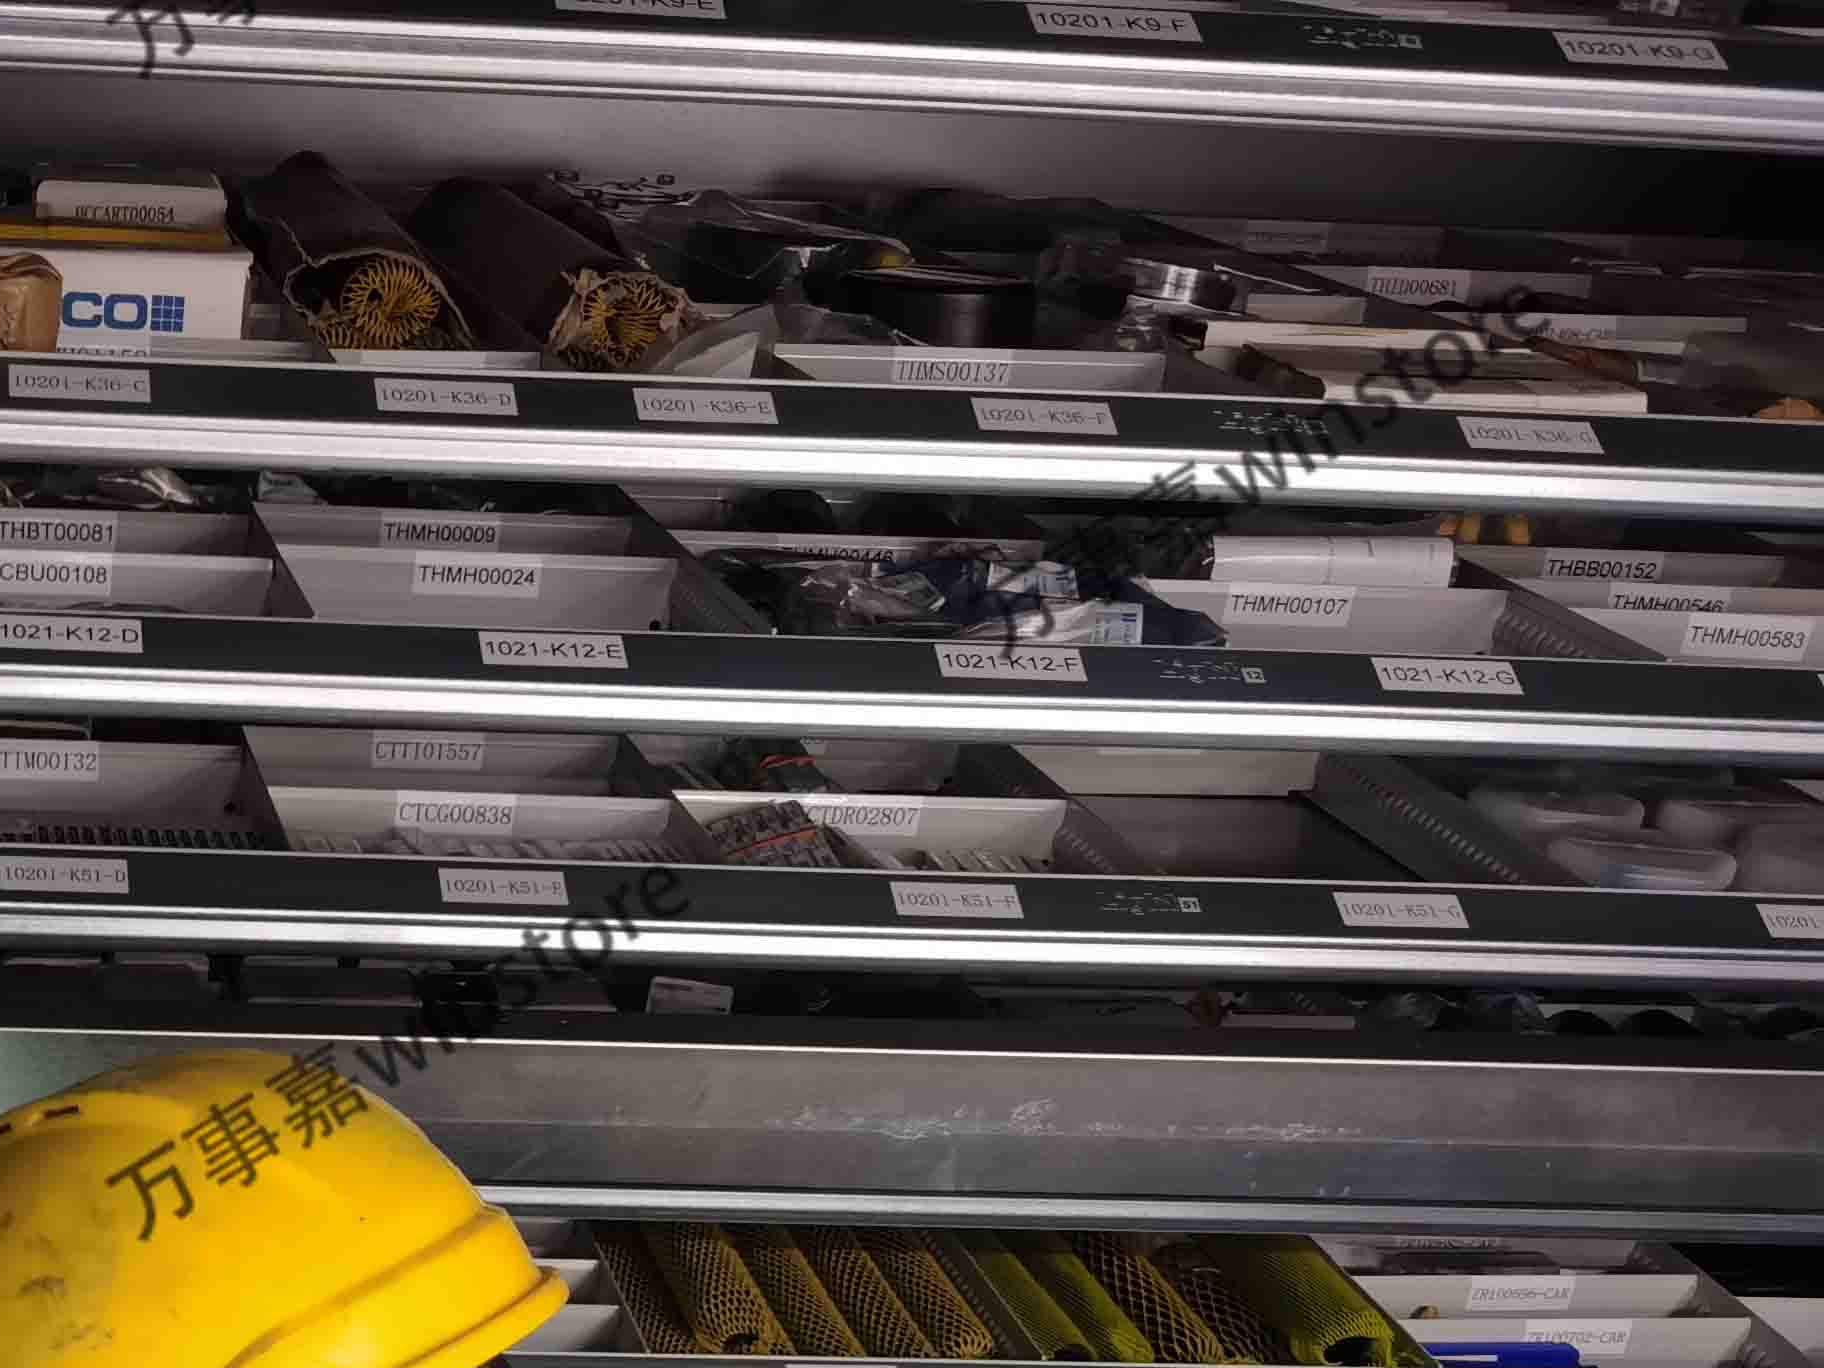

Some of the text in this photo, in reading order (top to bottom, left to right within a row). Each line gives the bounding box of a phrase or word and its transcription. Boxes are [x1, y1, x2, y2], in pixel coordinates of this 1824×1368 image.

[384, 524, 495, 543] THMH00009
[419, 566, 534, 584] THMH00024
[1548, 560, 1656, 579] THBB00152
[1232, 595, 1346, 615] THMH00107
[0, 624, 137, 643] 1021-K12-D
[1690, 626, 1804, 648] THMH00583
[485, 641, 622, 659] 1021-K12-E
[943, 653, 1077, 673] 1021-K12-F
[1381, 666, 1514, 685] 1021-K12-G
[399, 805, 511, 824] CTCG00838
